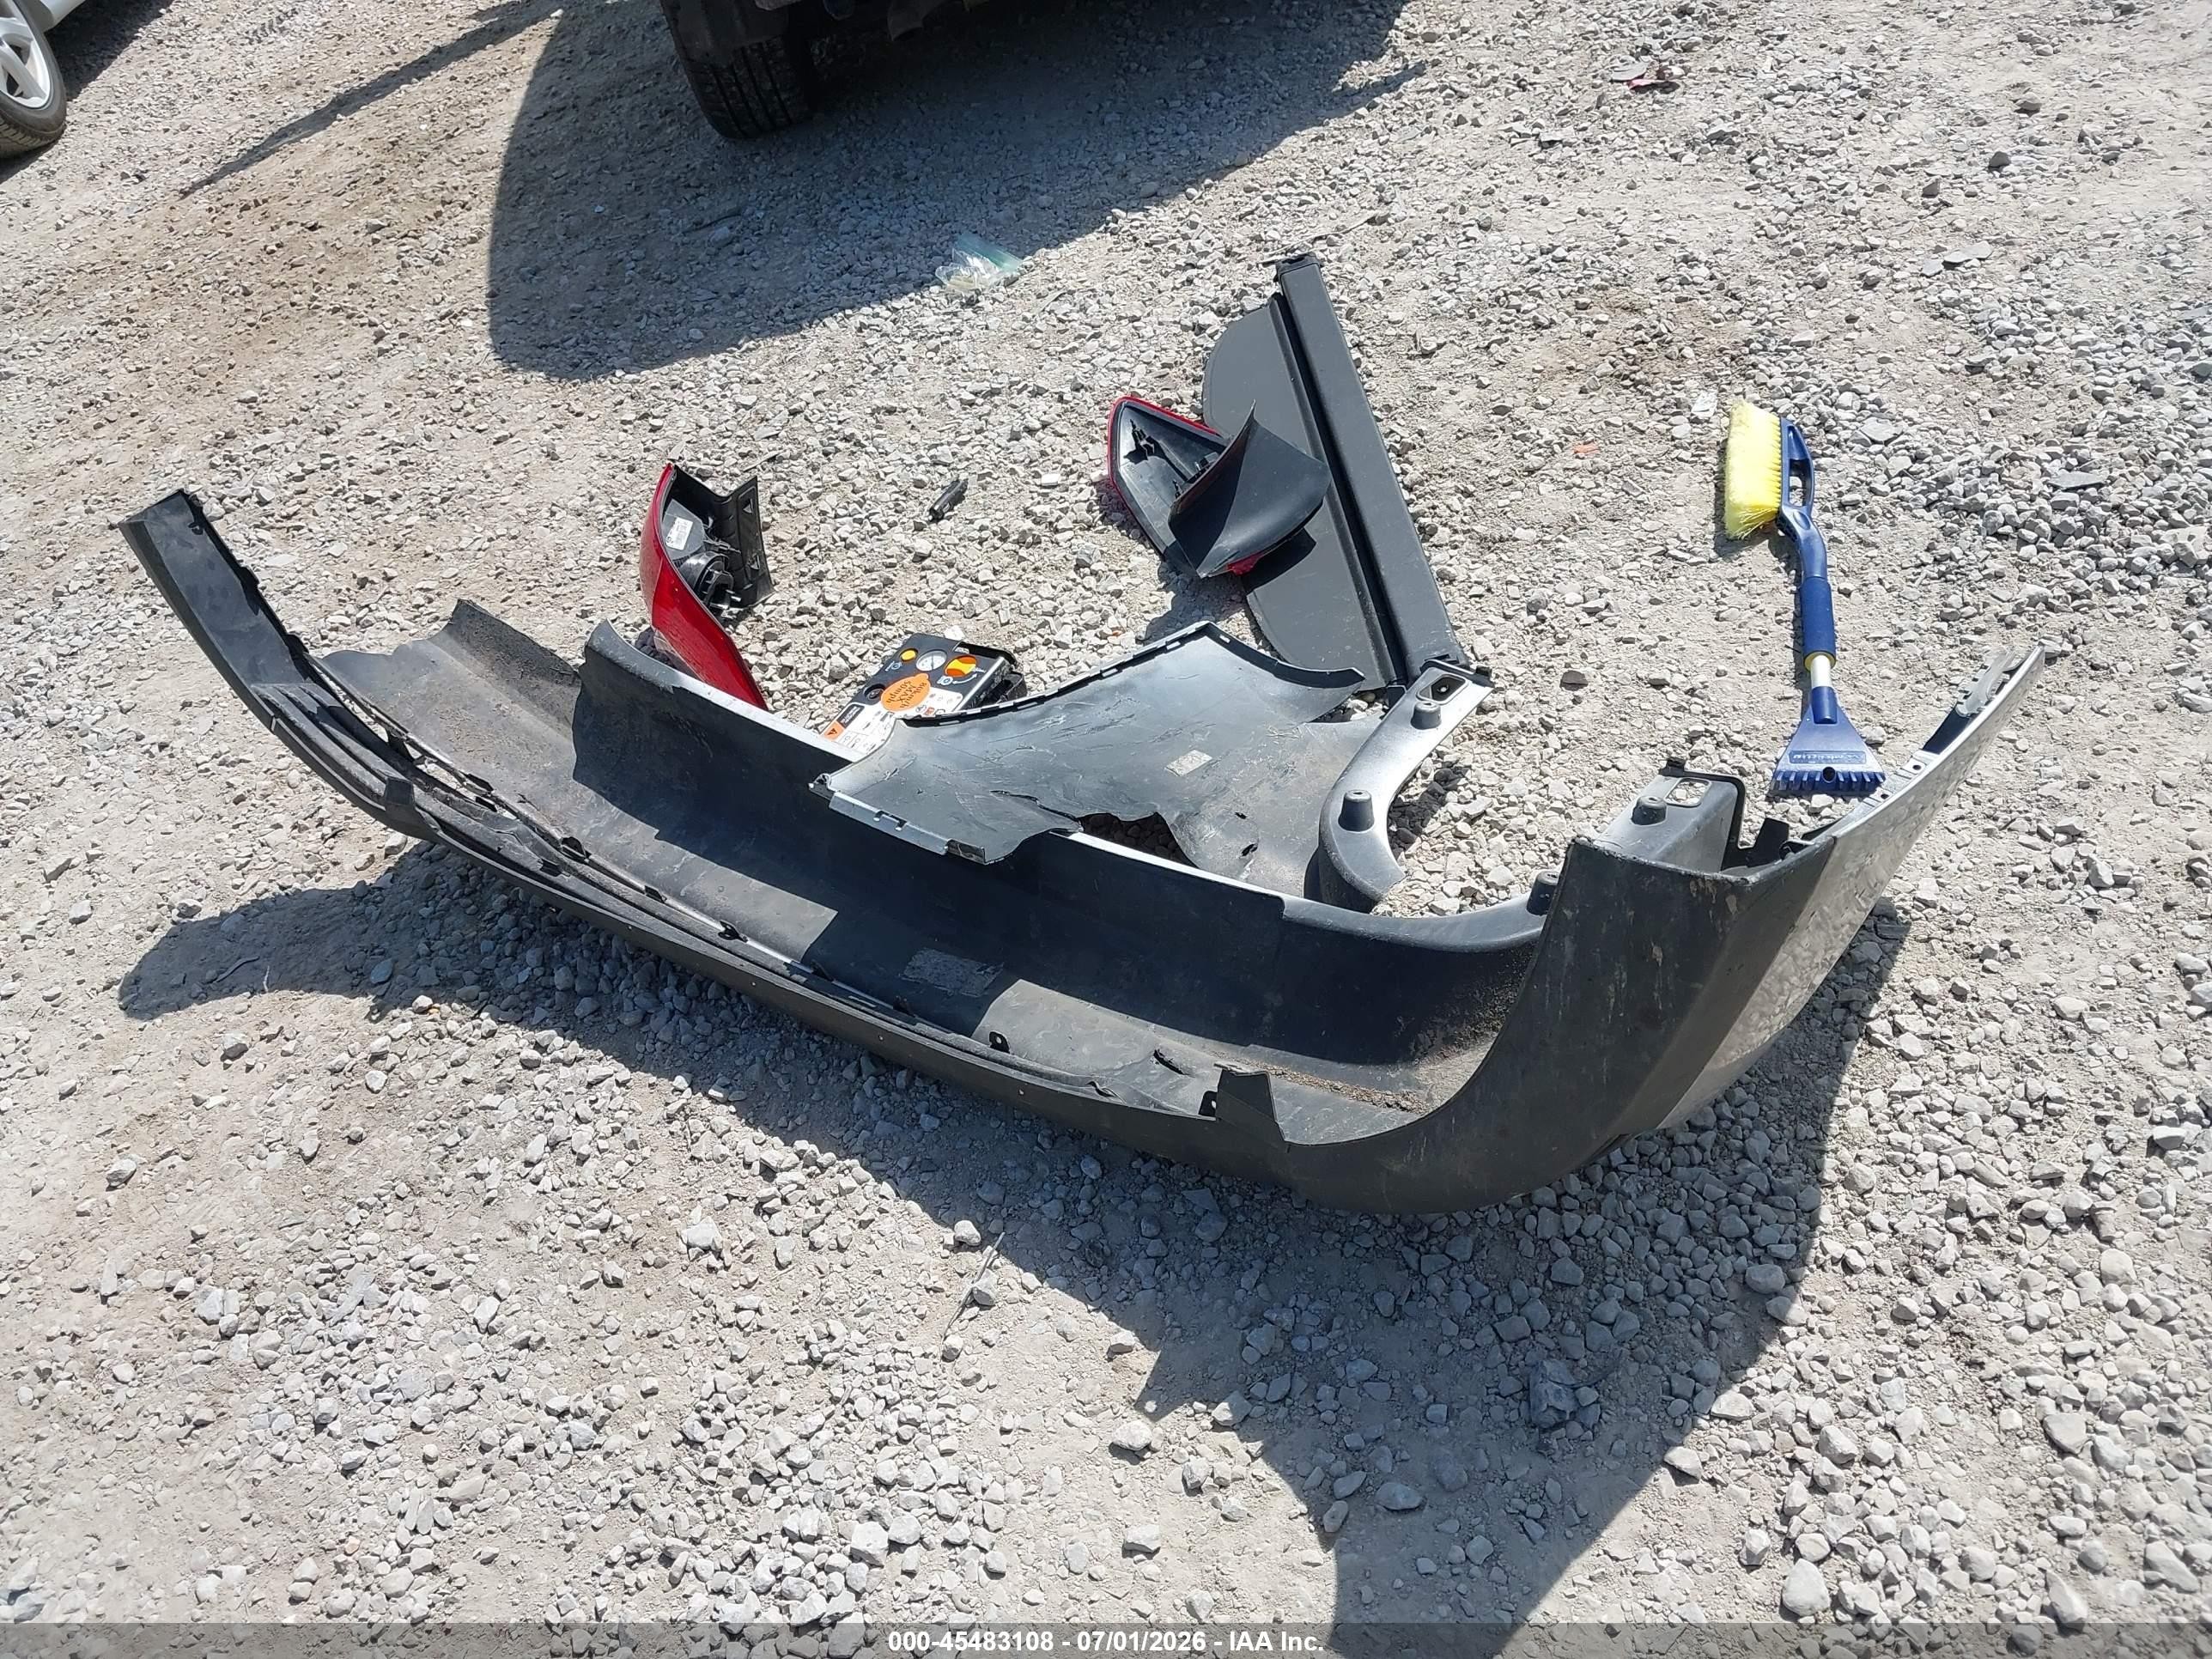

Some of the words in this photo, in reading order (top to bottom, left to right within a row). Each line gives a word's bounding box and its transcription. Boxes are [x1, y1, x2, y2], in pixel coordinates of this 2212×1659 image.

[885, 680, 912, 704] 50mph
[896, 683, 916, 703] MAX
[899, 682, 927, 708] 80km/h
